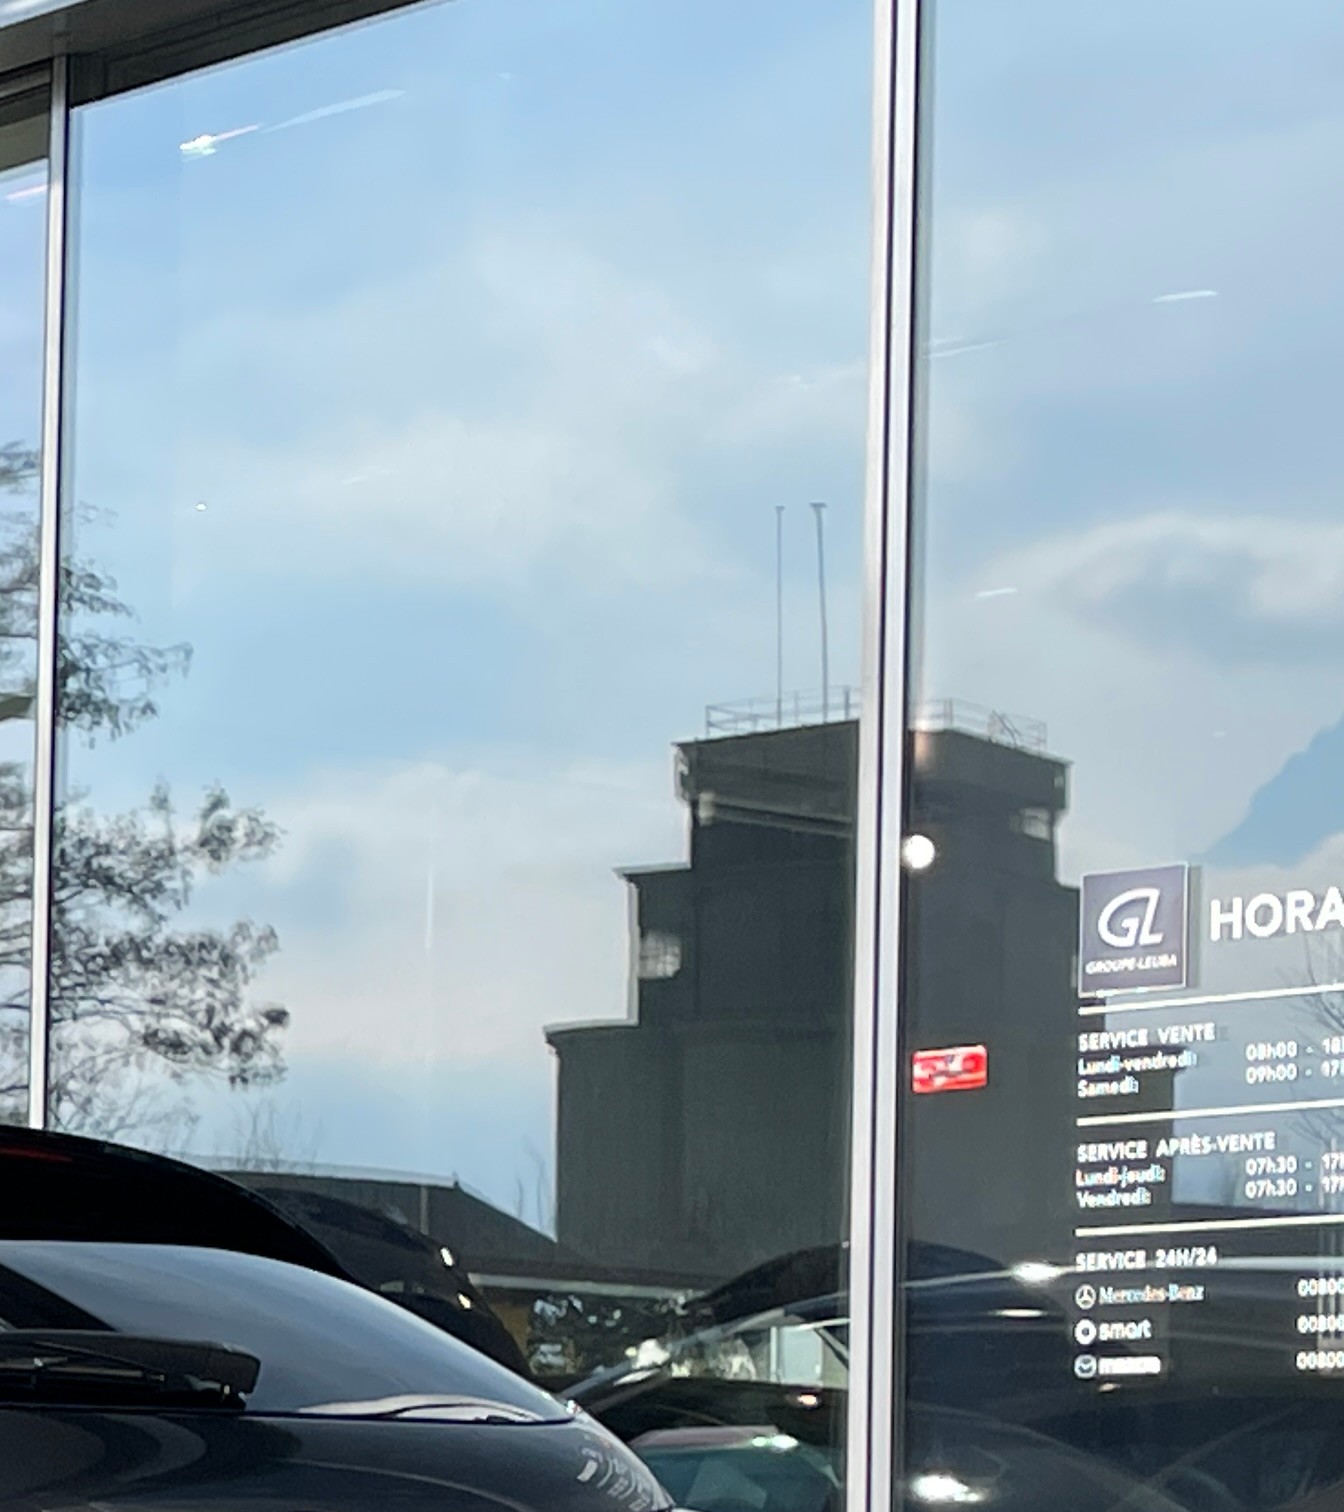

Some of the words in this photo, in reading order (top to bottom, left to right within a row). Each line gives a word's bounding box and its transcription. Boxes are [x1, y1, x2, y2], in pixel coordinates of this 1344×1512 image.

[1211, 886, 1344, 942] HORA
[1078, 1028, 1148, 1052] SERVICE
[1157, 1022, 1216, 1044] VENTE
[1322, 1036, 1344, 1054] 18
[1077, 1140, 1148, 1162] SERVICE
[1155, 1132, 1276, 1157] APRÈS-VENTE
[1245, 1156, 1297, 1176] 07h30
[1245, 1178, 1297, 1199] 07h30
[1075, 1250, 1146, 1271] SERVICE
[1155, 1246, 1217, 1268] 24H/24
[1098, 1283, 1205, 1304] Mercedes-Benz
[1098, 1319, 1152, 1341] smart
